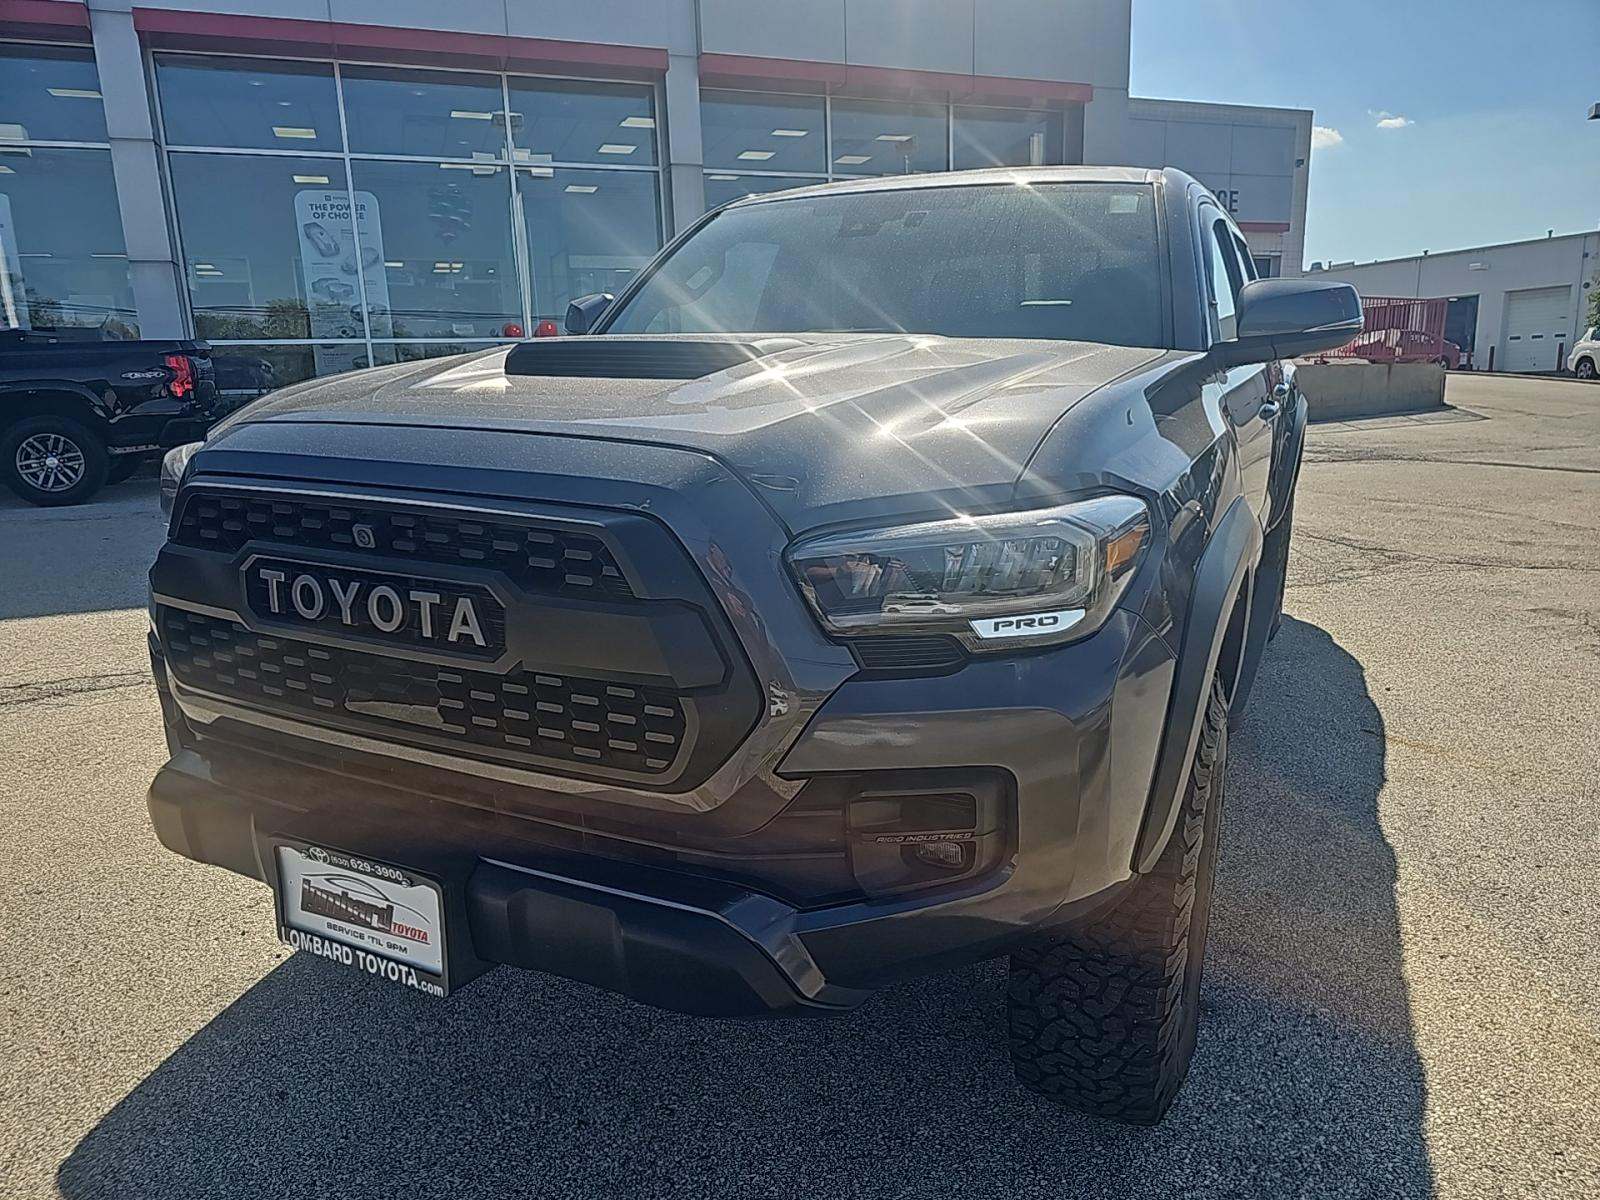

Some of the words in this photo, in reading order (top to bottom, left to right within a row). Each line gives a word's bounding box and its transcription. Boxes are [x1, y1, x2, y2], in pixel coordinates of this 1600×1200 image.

[309, 203, 328, 211] THE
[259, 568, 487, 648] TOYOTA
[993, 615, 1059, 632] PRO
[905, 832, 972, 842] INDUSTRIES
[350, 858, 403, 881] 629-3900
[326, 921, 366, 941] SERVICE
[391, 921, 429, 942] TOYOTA
[281, 926, 353, 966] LOMBARD
